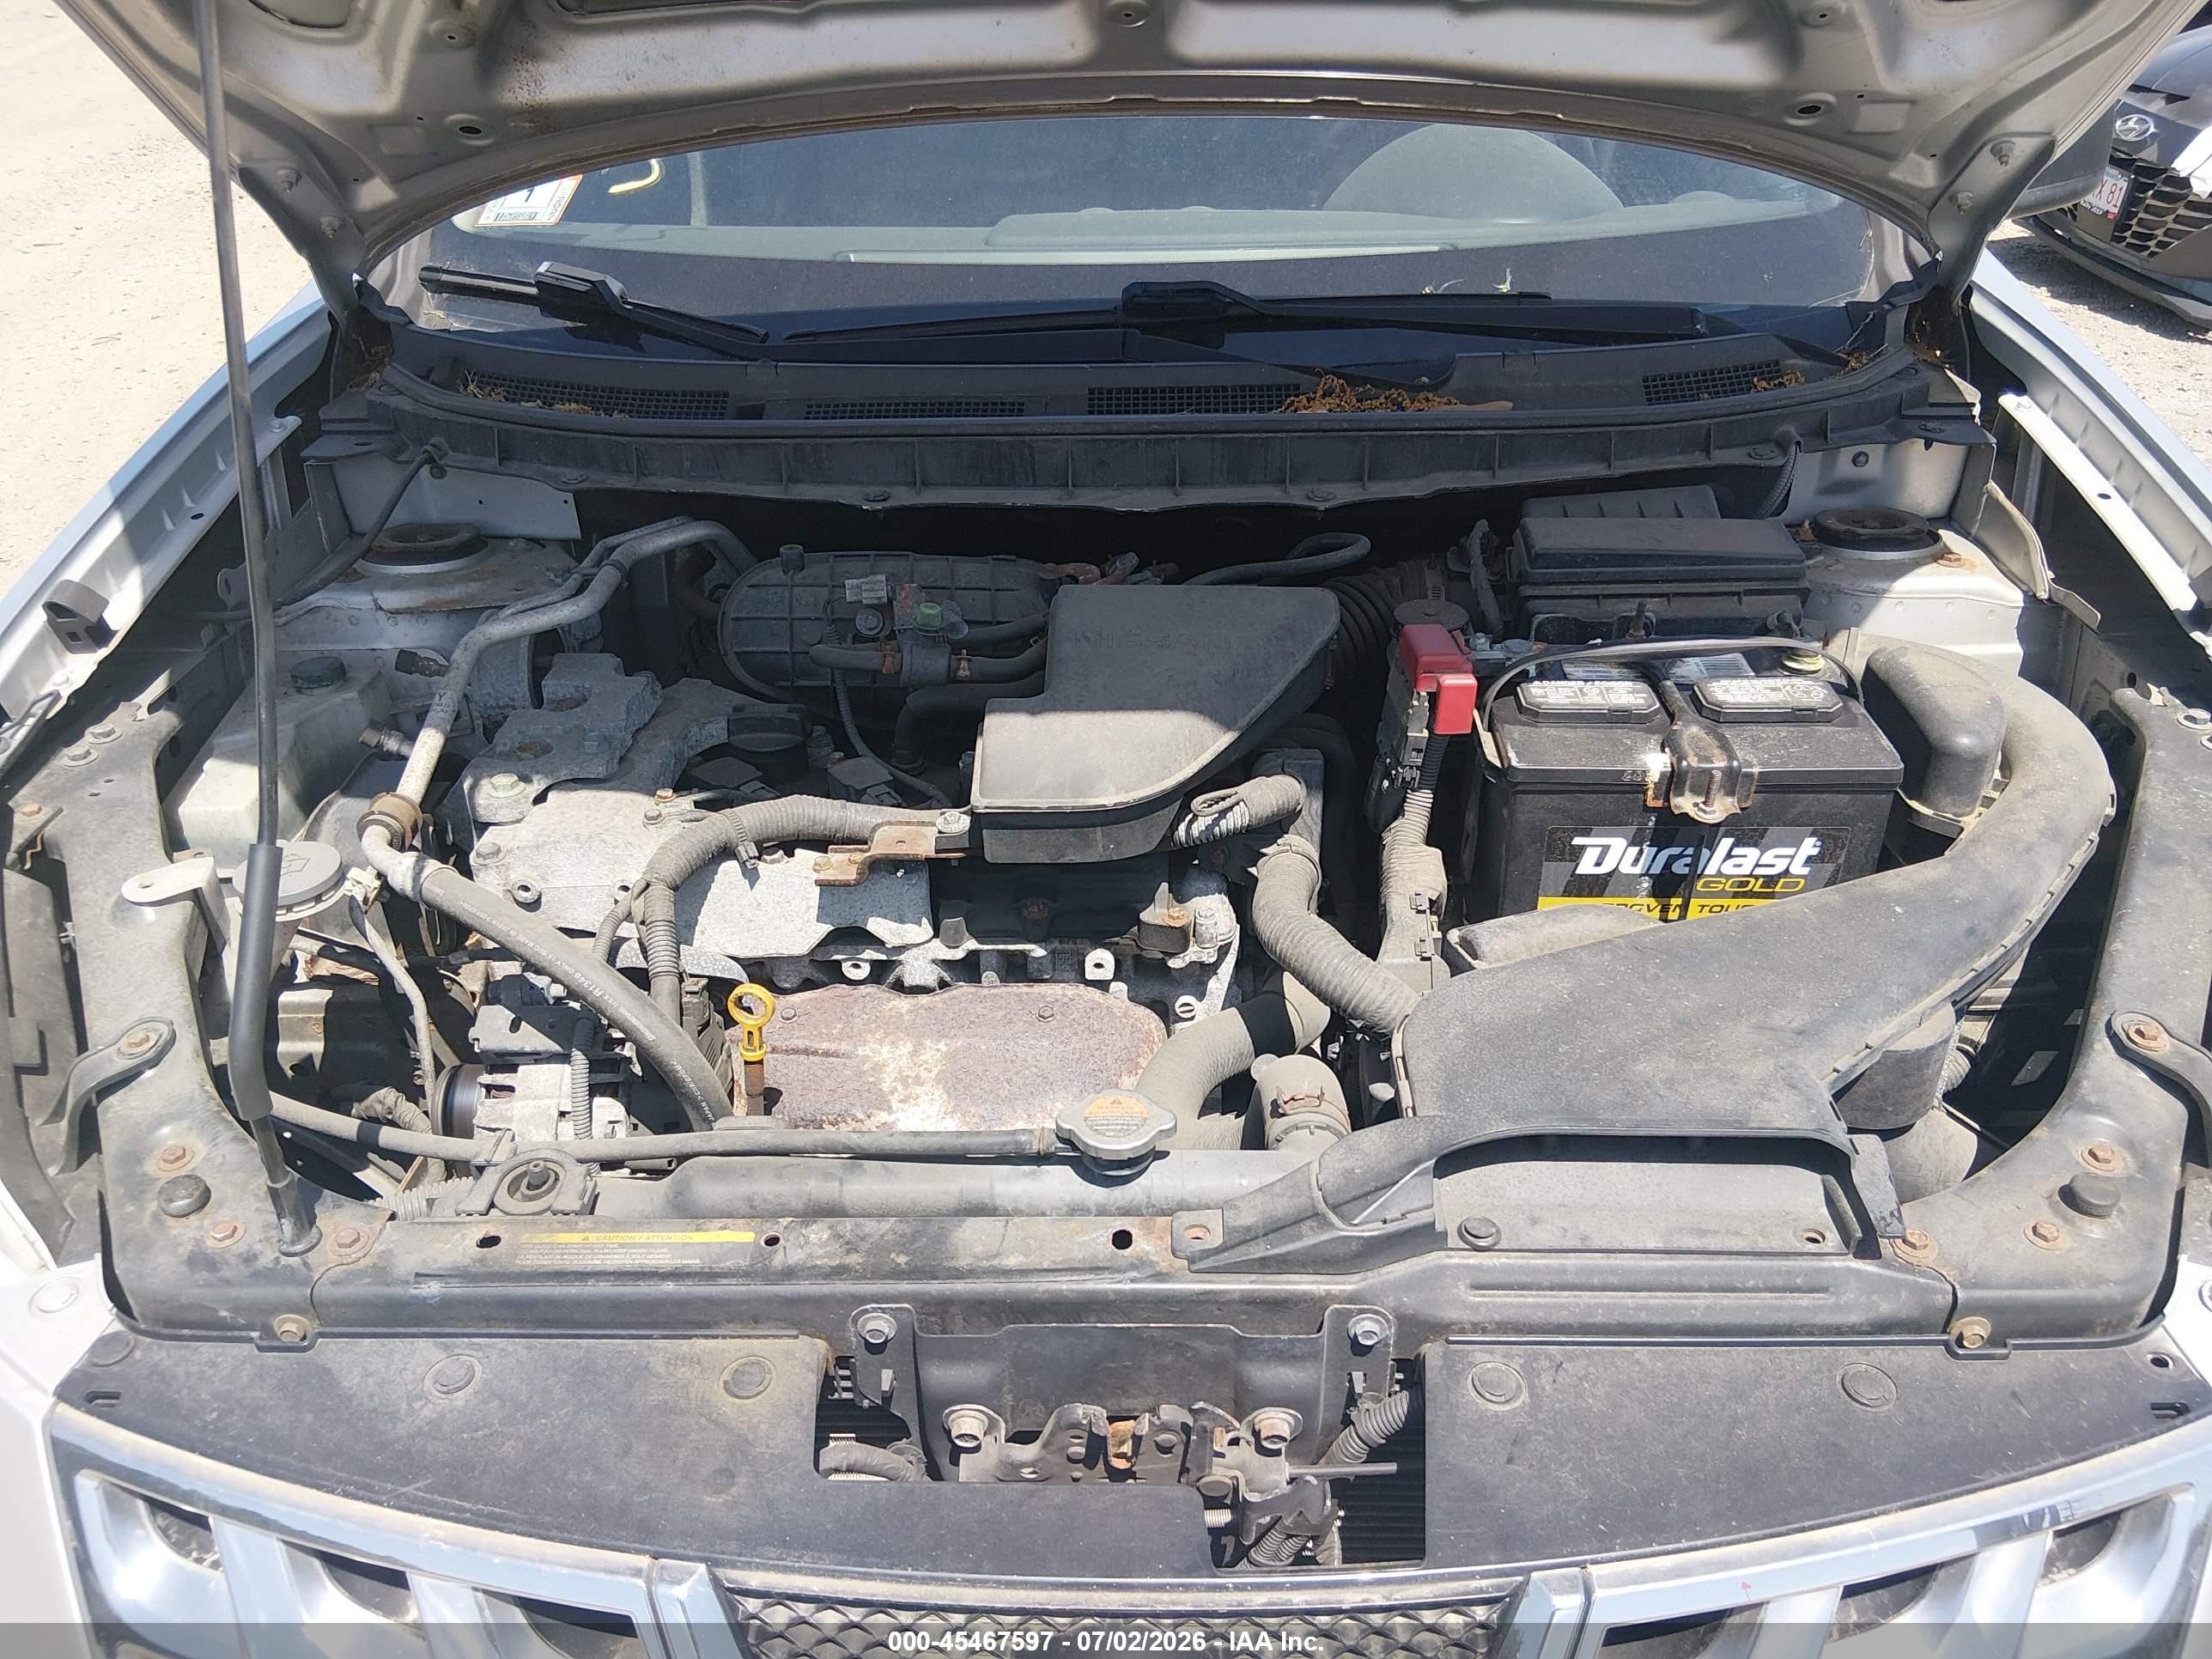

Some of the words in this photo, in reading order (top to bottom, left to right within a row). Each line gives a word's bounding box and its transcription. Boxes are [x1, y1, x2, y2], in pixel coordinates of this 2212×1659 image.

[2106, 183, 2124, 209] 81
[1571, 836, 1820, 876] Duralast
[1695, 877, 1806, 892] GOLD
[574, 972, 605, 997] R134a
